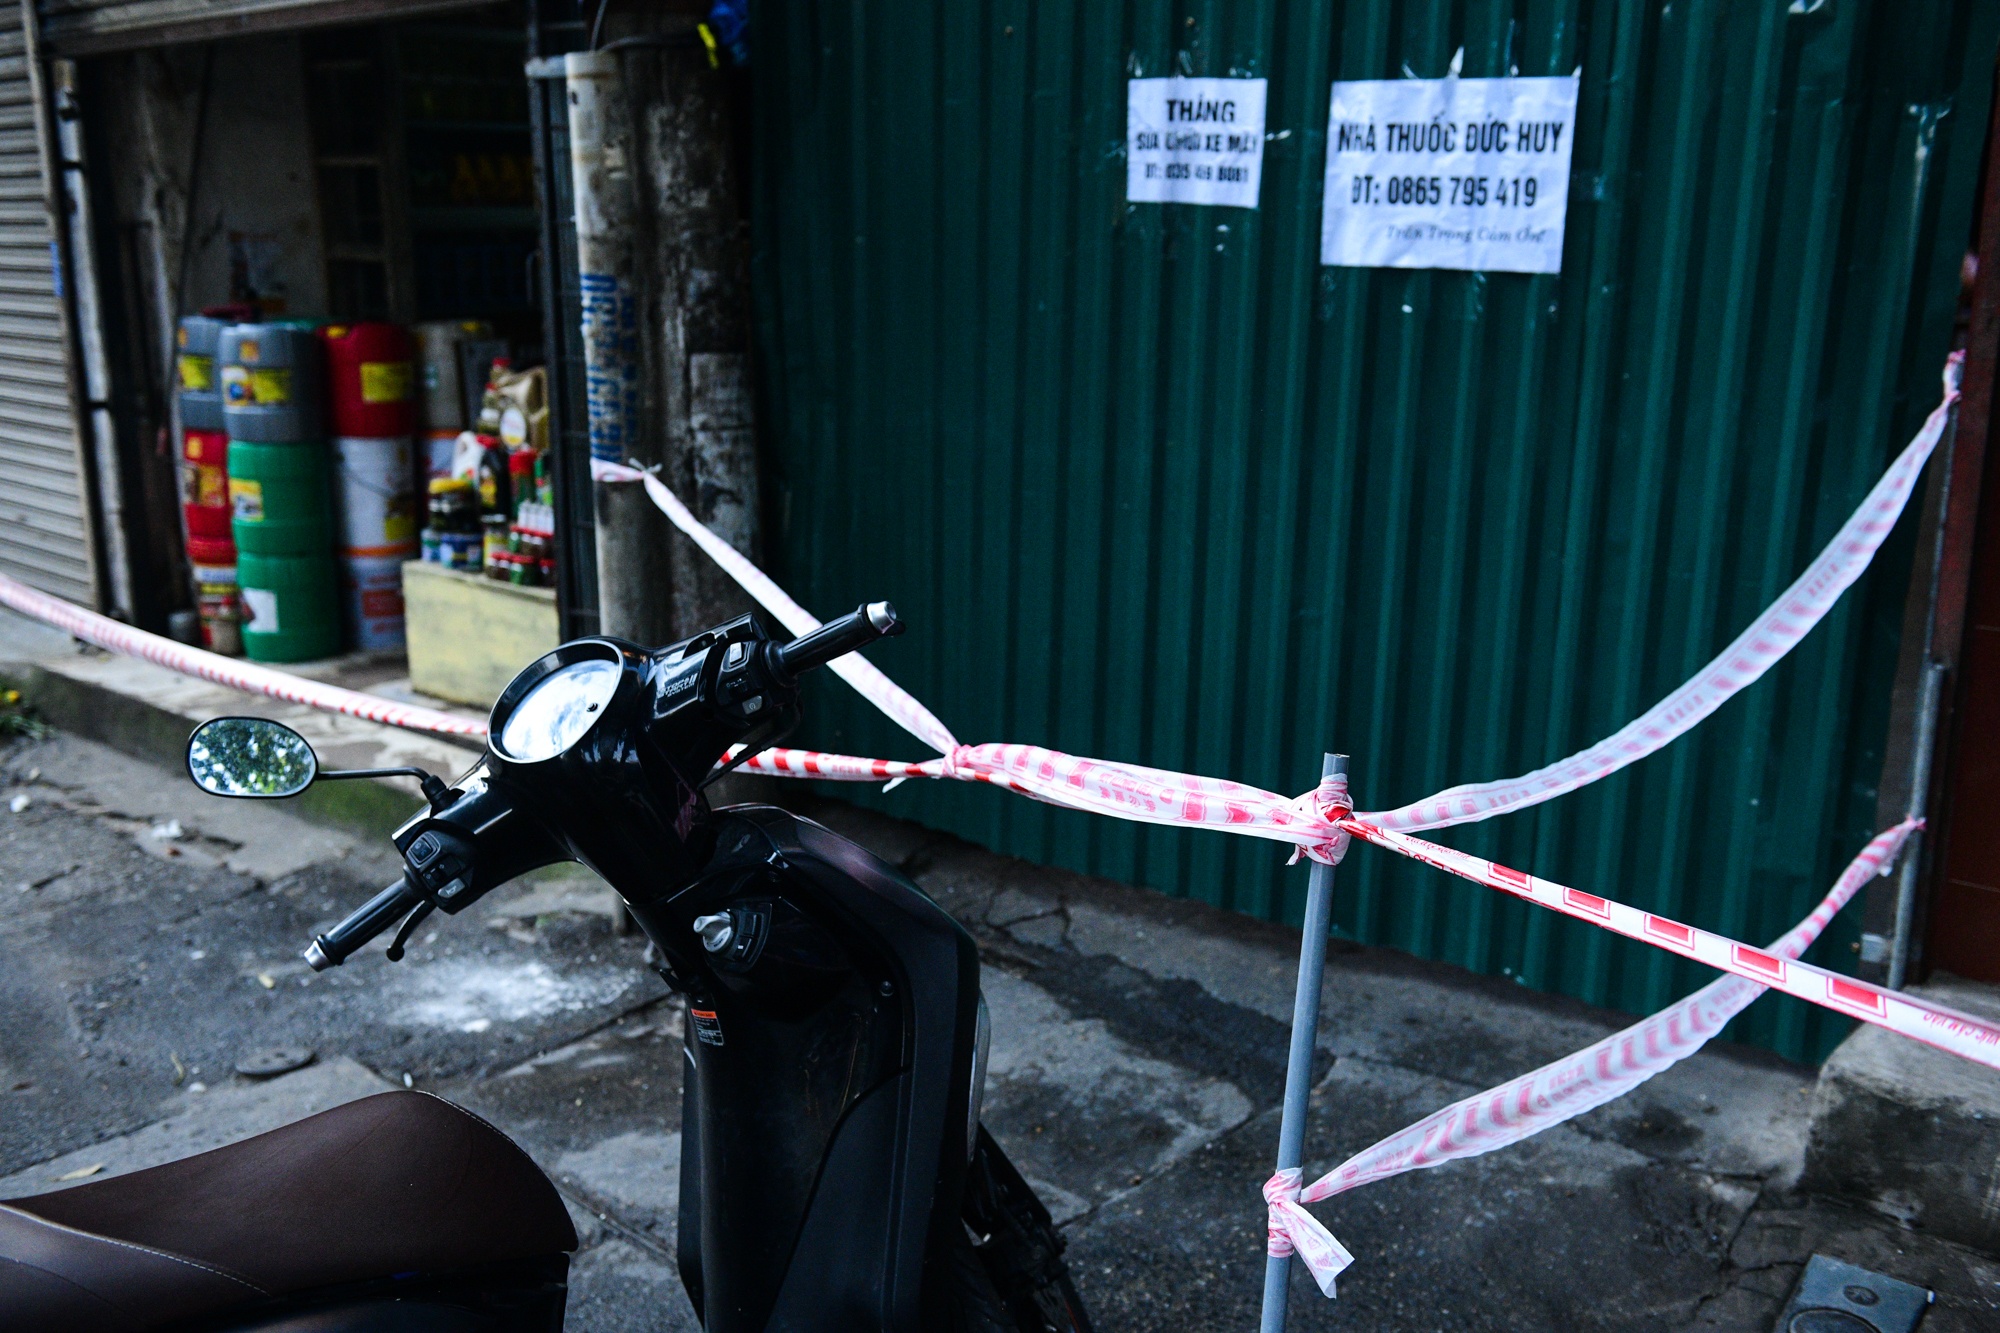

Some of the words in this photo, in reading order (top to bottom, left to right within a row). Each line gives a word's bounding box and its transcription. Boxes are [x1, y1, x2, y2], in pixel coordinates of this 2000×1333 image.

[1387, 110, 1457, 152] THUỐC
[1465, 112, 1509, 153] ĐỨC
[1517, 122, 1563, 153] HUY
[1388, 176, 1441, 205] 0865
[1450, 177, 1488, 206] 795
[1496, 178, 1537, 207] 419
